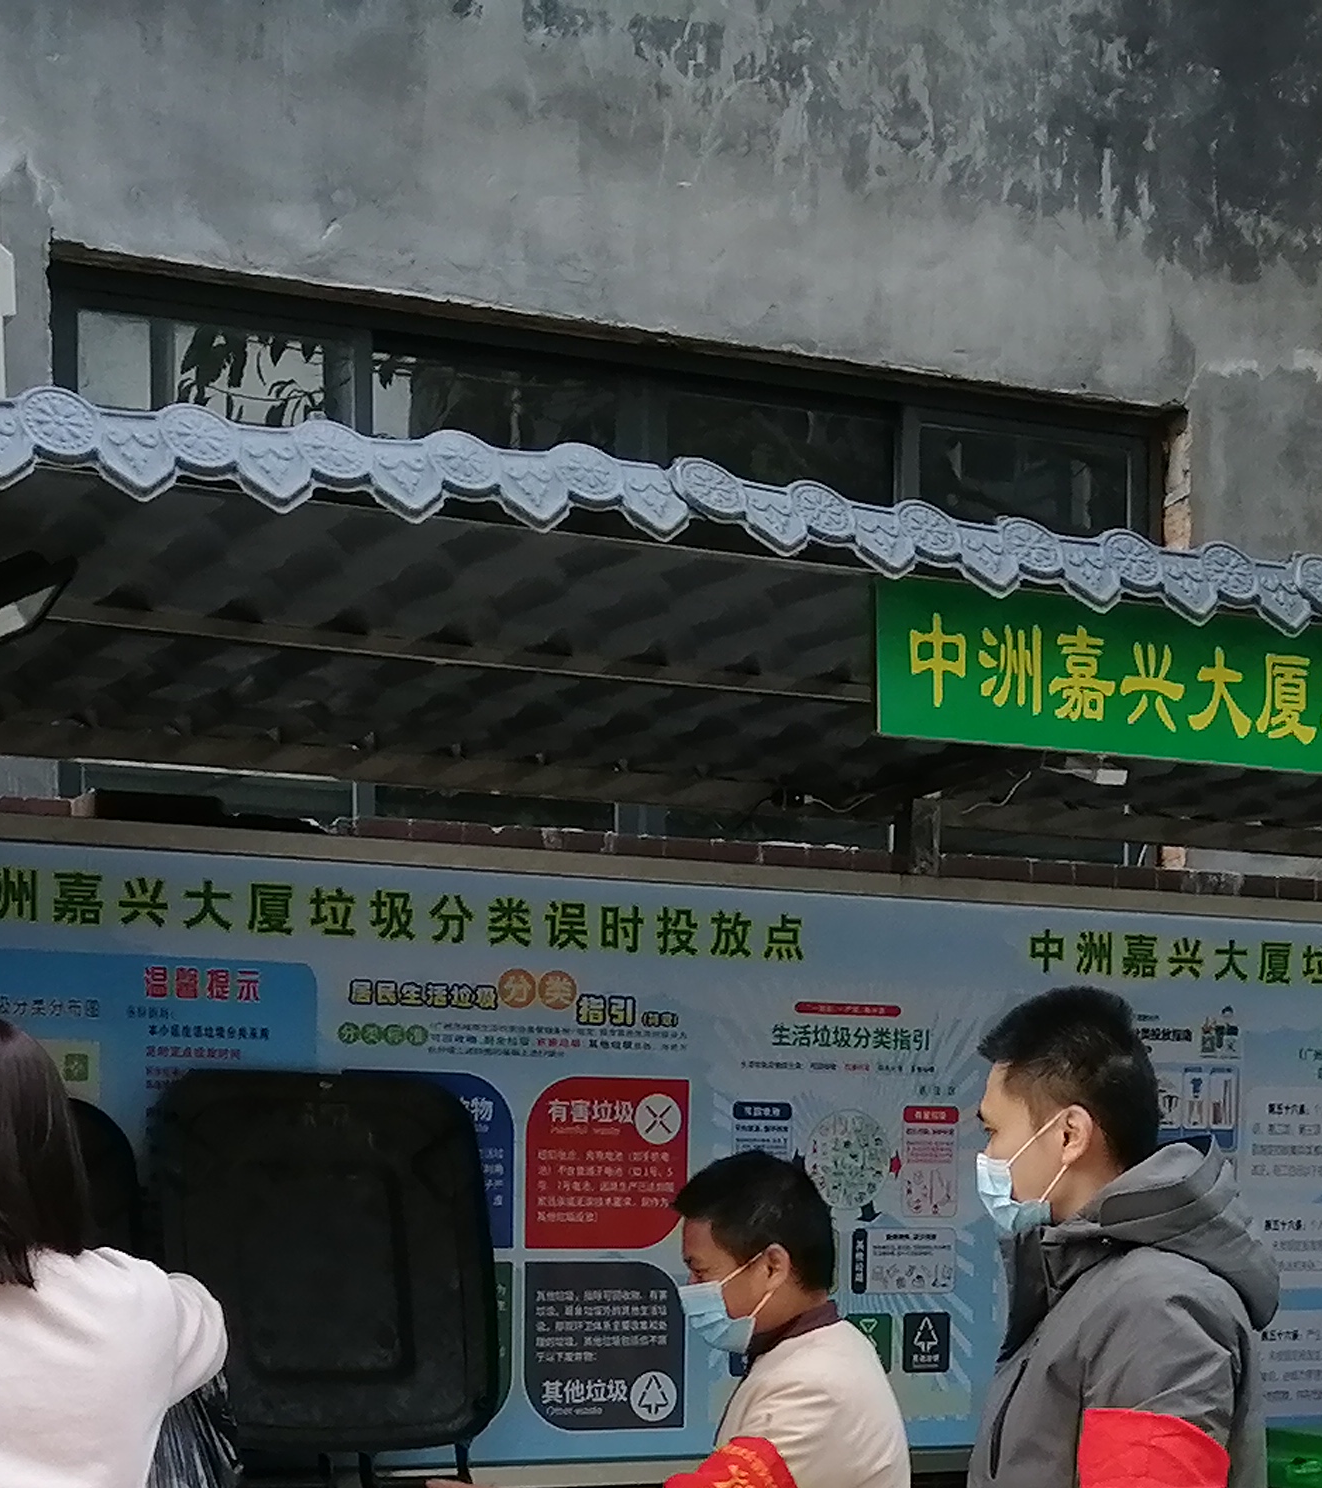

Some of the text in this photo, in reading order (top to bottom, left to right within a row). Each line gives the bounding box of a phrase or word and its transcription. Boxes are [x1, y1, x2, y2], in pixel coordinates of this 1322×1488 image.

[144, 965, 262, 1003] 温馨提示
[771, 1023, 932, 1051] 生活垃圾分类指引
[548, 1098, 634, 1124] 有害垃圾
[541, 1379, 629, 1404] 其他垃圾
